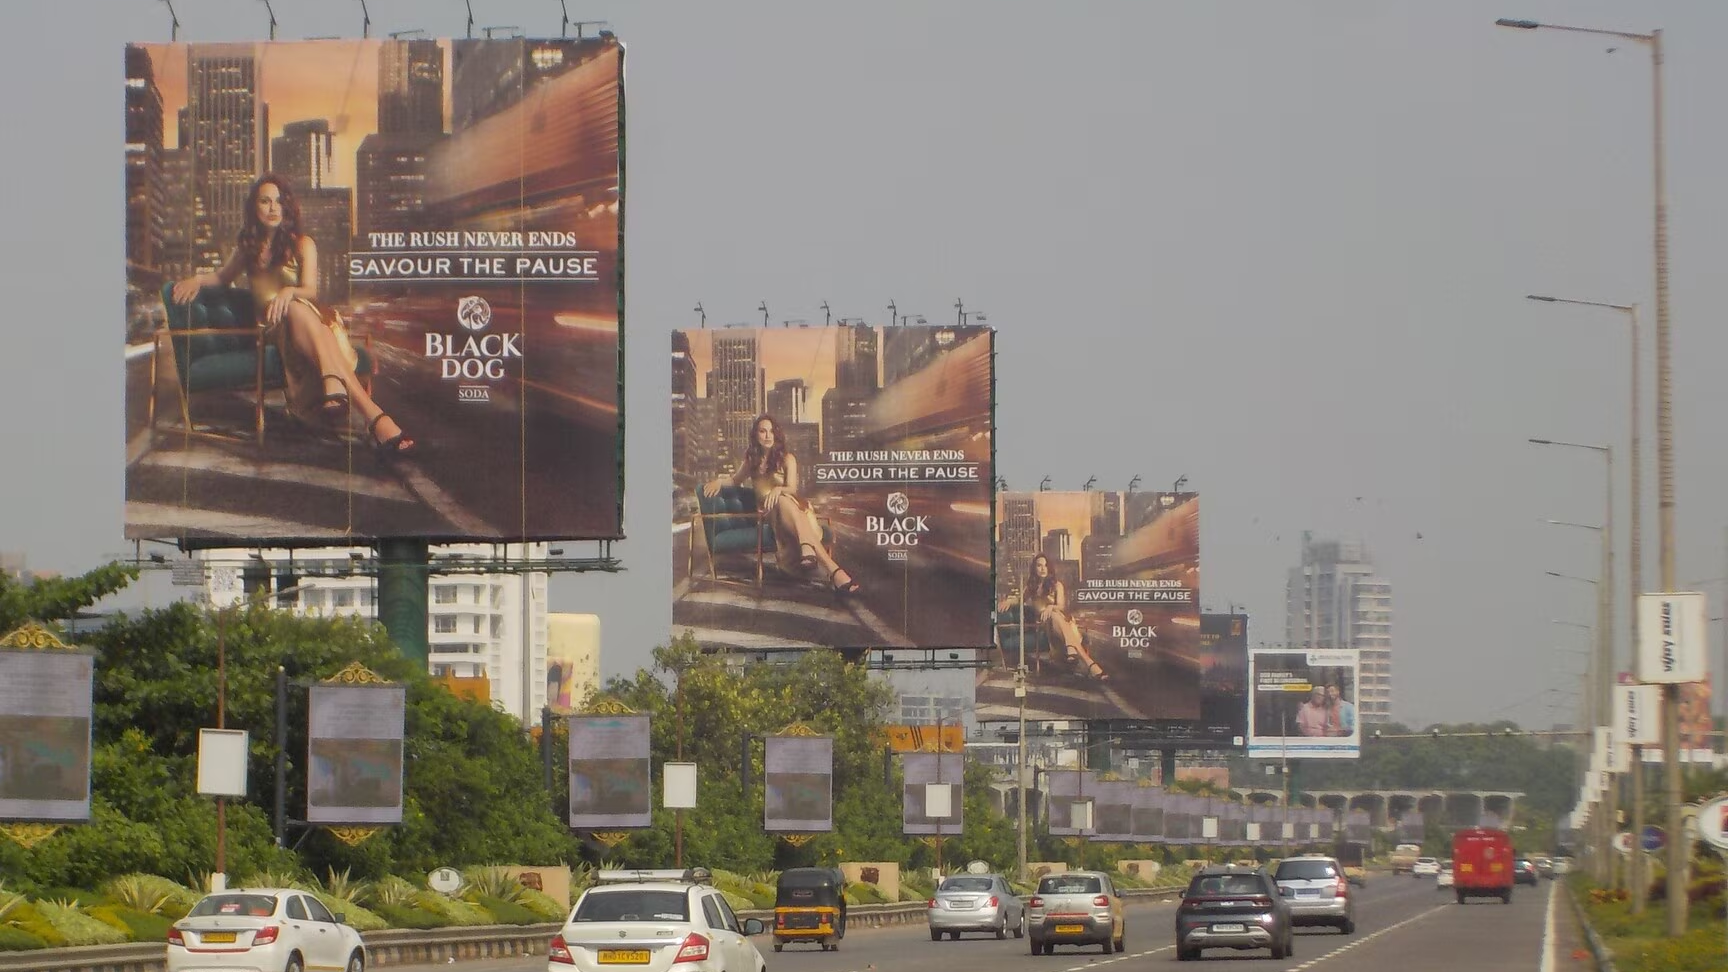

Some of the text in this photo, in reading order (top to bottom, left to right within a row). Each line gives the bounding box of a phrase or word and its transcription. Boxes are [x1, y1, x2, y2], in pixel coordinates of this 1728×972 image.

[368, 231, 576, 247] THE RUSH NEVER ENDS
[349, 257, 598, 276] SAVOUR THE PAUSE
[424, 332, 523, 357] BLACK
[441, 358, 505, 379] DOG
[458, 388, 490, 399] SODA
[829, 449, 965, 462] THE RUSH NEVER ENDS
[817, 466, 979, 480] SAVOUR THE PAUSE
[866, 515, 930, 532] BLACK
[876, 532, 919, 546] DOG
[1086, 579, 1182, 588] THE RUSH NEVER ENDS
[1077, 591, 1192, 601] SAVOUR THE PAUSE
[1112, 625, 1157, 638] BLACK
[1120, 637, 1150, 648] DOG
[1662, 640, 1676, 672] vijay
